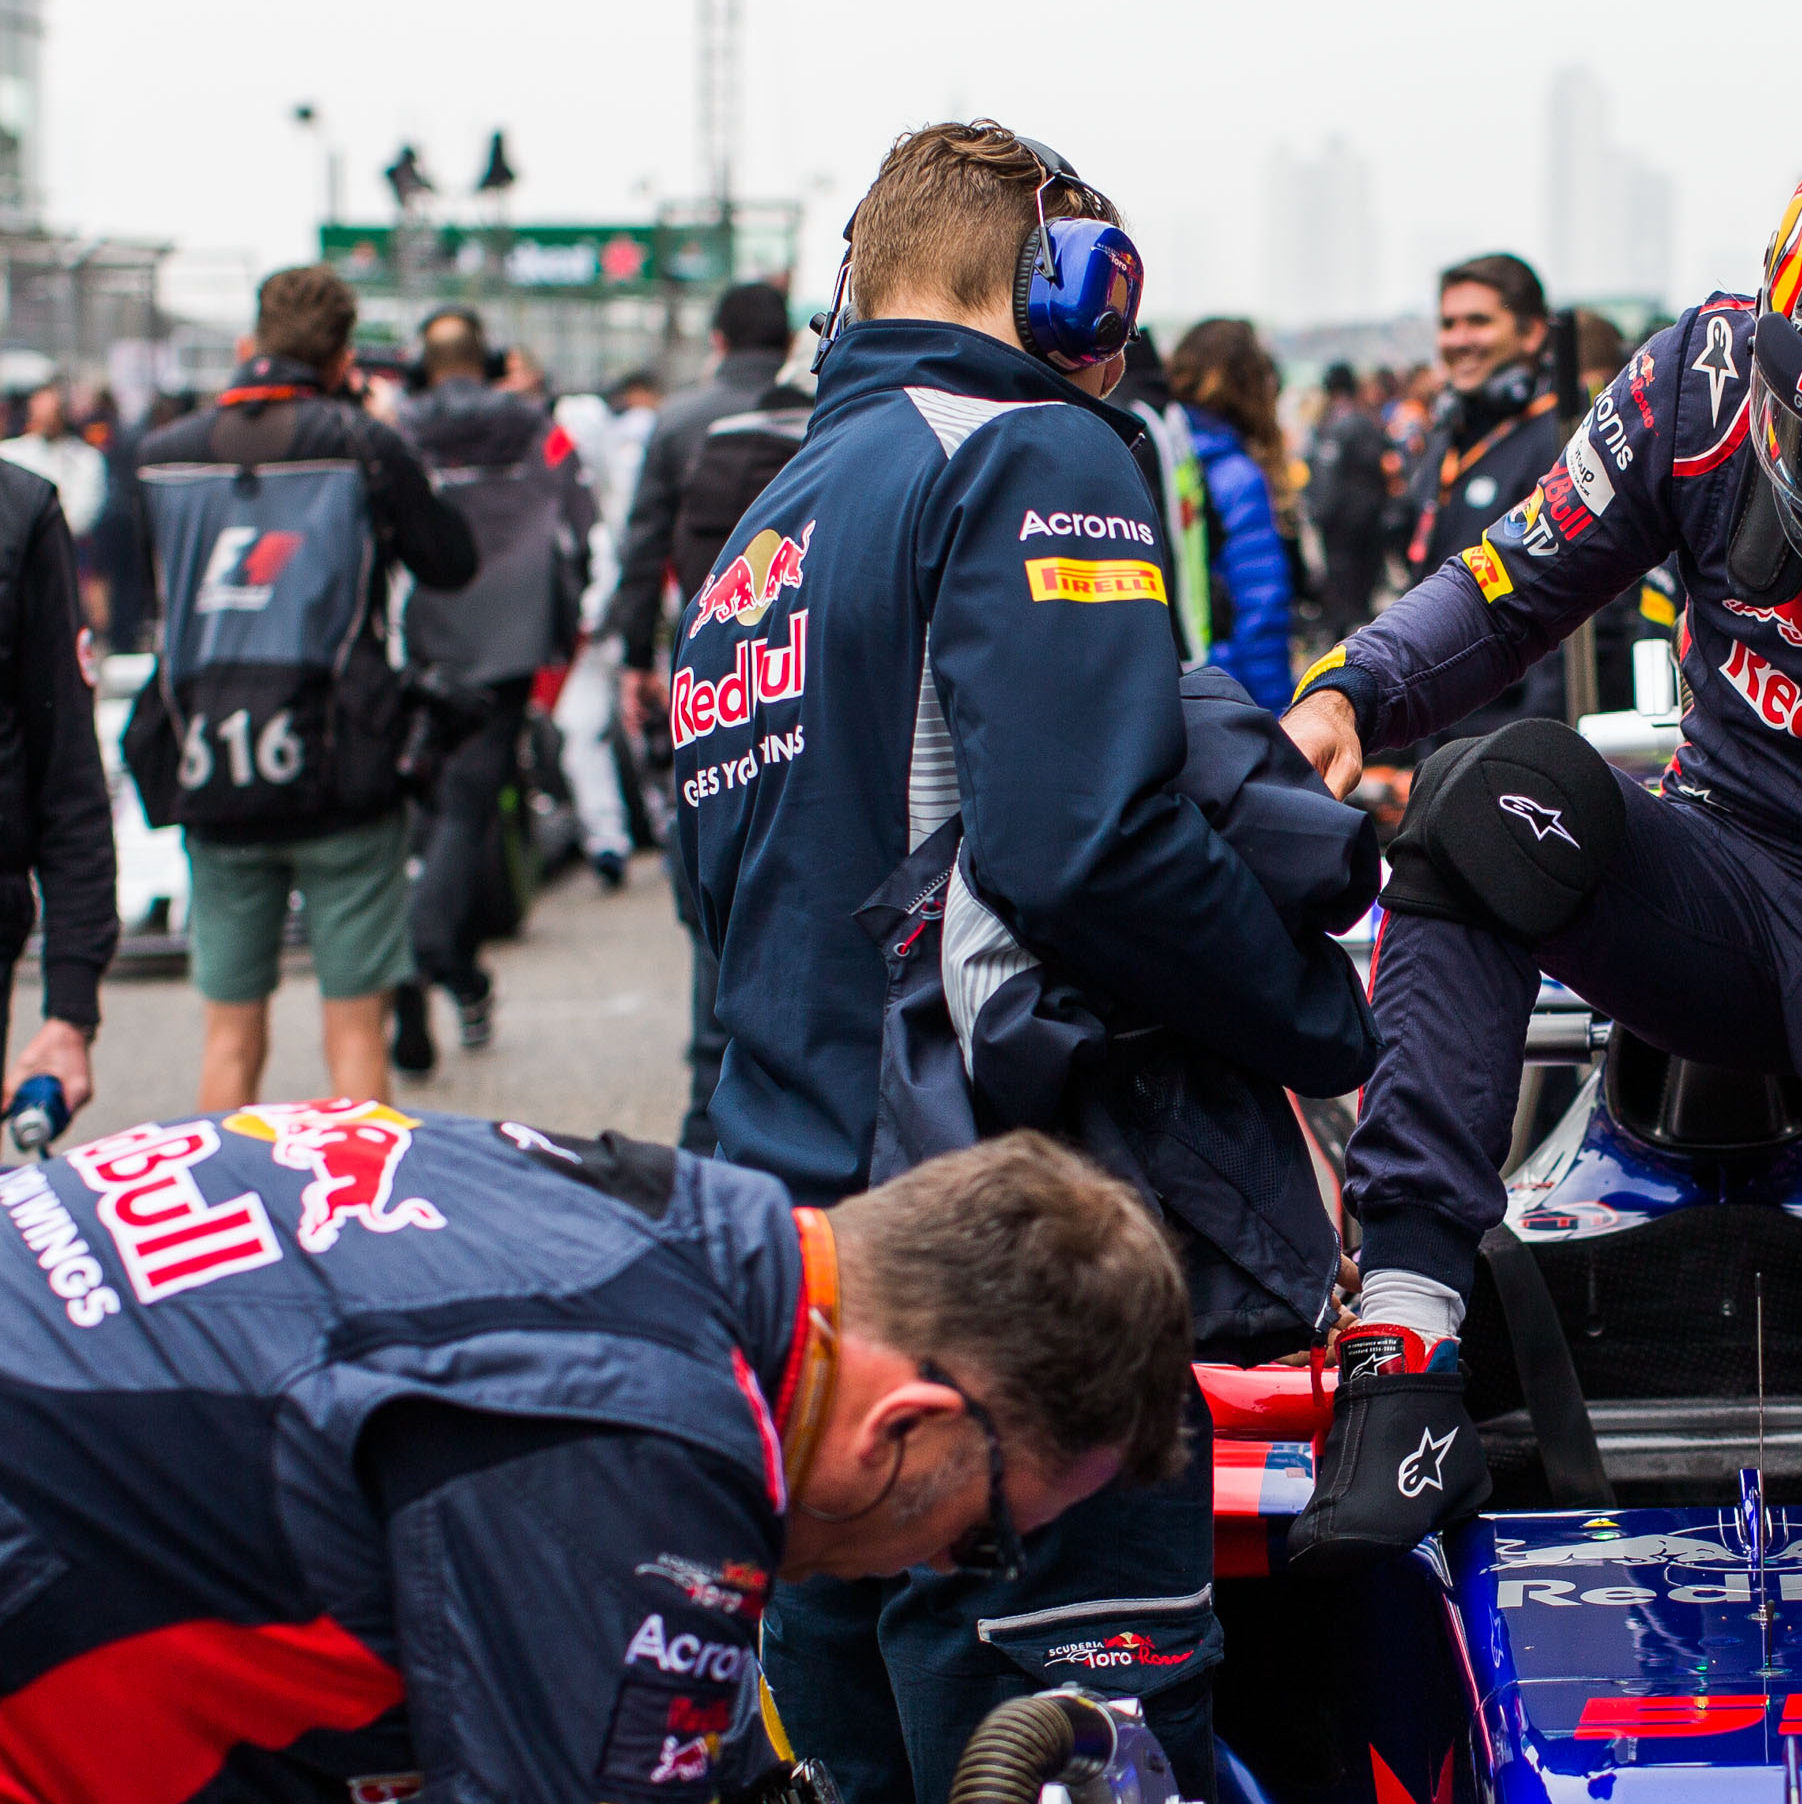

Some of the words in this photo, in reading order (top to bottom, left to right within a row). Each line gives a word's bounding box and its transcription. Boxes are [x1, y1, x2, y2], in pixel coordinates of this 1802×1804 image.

[1019, 510, 1155, 546] Acronis
[1522, 513, 1559, 557] TV
[1040, 566, 1158, 594] PIRELLI
[177, 708, 304, 791] 616
[1049, 1641, 1105, 1657] SCUDERIA
[1085, 1650, 1133, 1669] Toro
